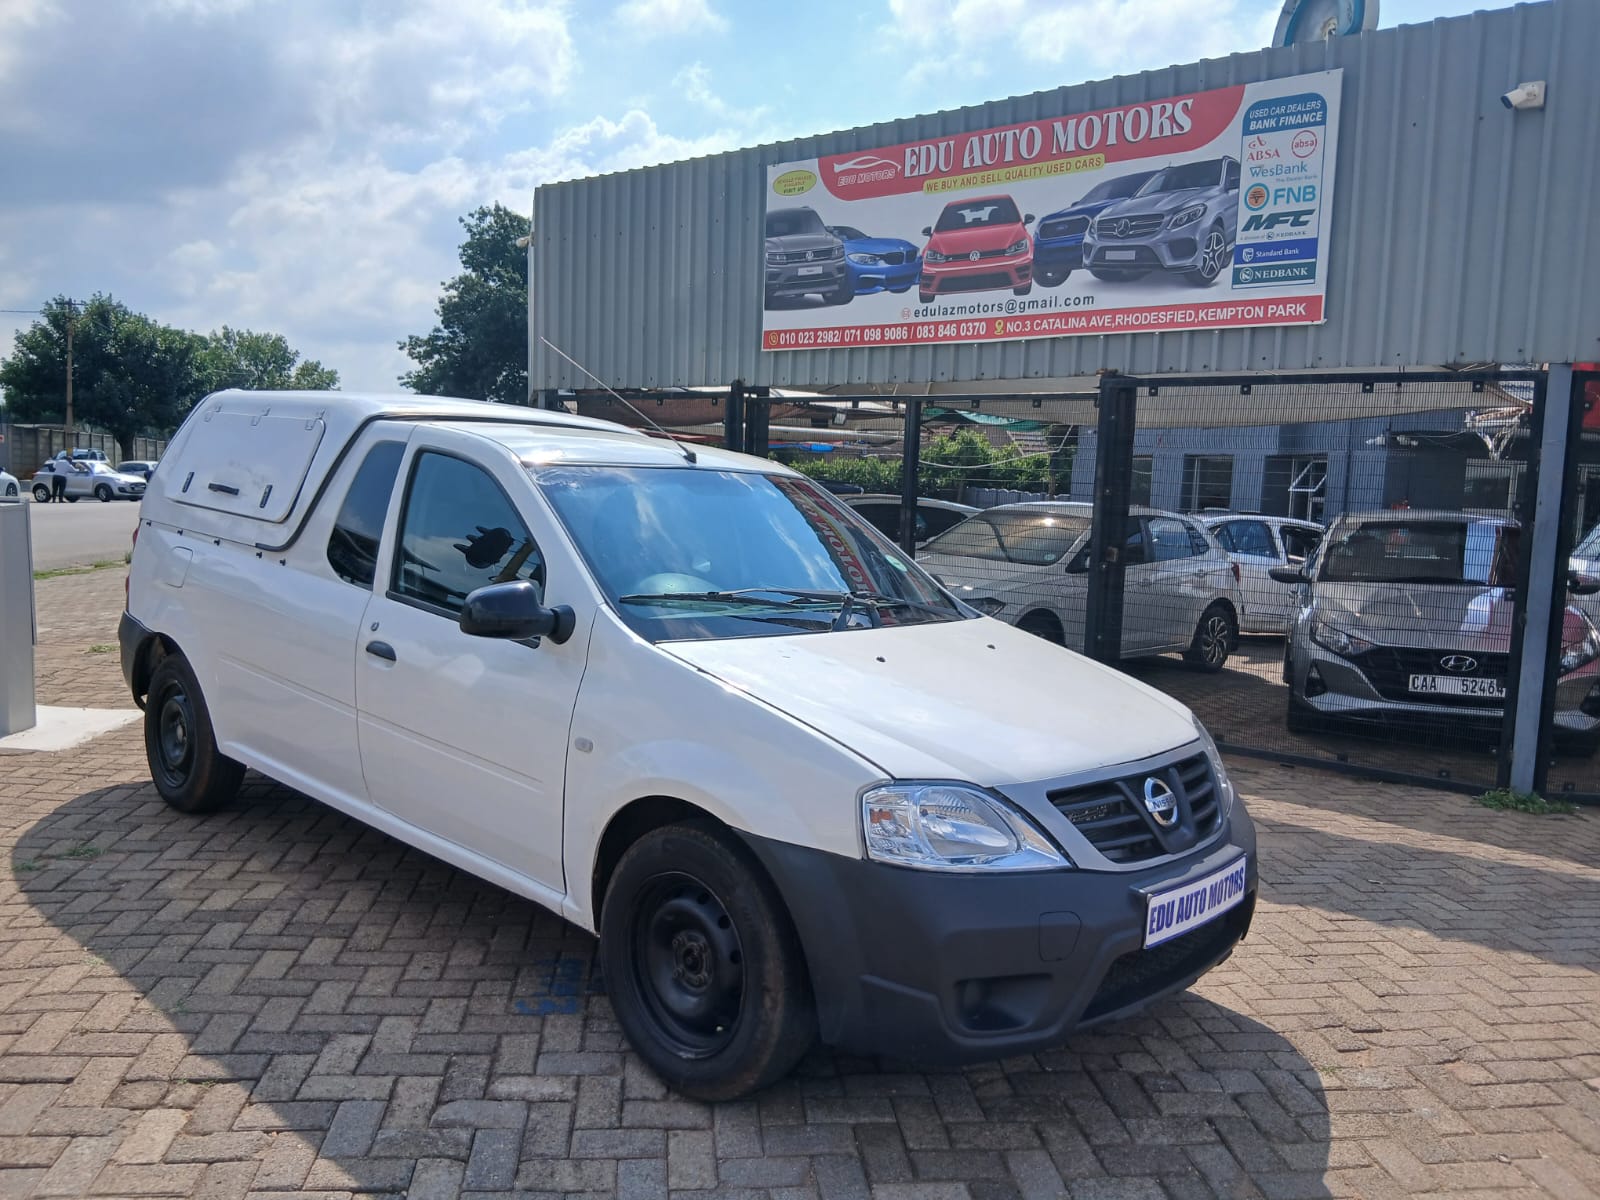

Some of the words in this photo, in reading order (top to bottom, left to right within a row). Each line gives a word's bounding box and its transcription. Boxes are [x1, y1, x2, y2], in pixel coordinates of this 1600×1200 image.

[1250, 108, 1269, 119] USED
[1270, 106, 1285, 115] CAR
[1287, 100, 1321, 112] DEALERS
[1249, 118, 1276, 130] BANK
[1279, 112, 1323, 126] FINANCE
[904, 141, 955, 177] EDU
[963, 126, 1042, 169] AUTO
[1052, 99, 1194, 154] MOTORS
[1294, 139, 1315, 149] absa
[1247, 148, 1280, 161] ABSA
[837, 175, 856, 187] EDU
[857, 169, 896, 184] MOTORS
[926, 182, 939, 192] WE
[942, 179, 957, 190] BUY
[960, 176, 978, 187] AND
[981, 173, 1001, 185] SELL
[1005, 166, 1043, 182] QUALITY
[1047, 162, 1072, 174] USED
[1075, 157, 1102, 169] CARS
[1249, 161, 1308, 177] WesBank
[1273, 184, 1316, 206] FNB
[1241, 209, 1316, 232] MFC
[1255, 249, 1283, 258] Standard
[1284, 248, 1299, 256] Bank
[1254, 267, 1308, 279] NEDBANK
[914, 295, 1095, 318] edulazmotors@gmail.com
[1006, 320, 1031, 333] NO.3
[1033, 315, 1087, 330] CATALINA
[1267, 303, 1307, 316] PARK
[780, 335, 796, 345] 010
[798, 333, 815, 344] 023
[845, 330, 861, 342] 071
[864, 328, 881, 341] 098
[884, 326, 908, 340] 9086
[917, 324, 935, 338] 083
[938, 323, 957, 337] 846
[960, 321, 987, 336] 0370
[1412, 675, 1437, 691] CAA
[1148, 899, 1175, 935] EDU
[1176, 886, 1207, 924] AUTO
[1207, 866, 1244, 910] MOTORS
